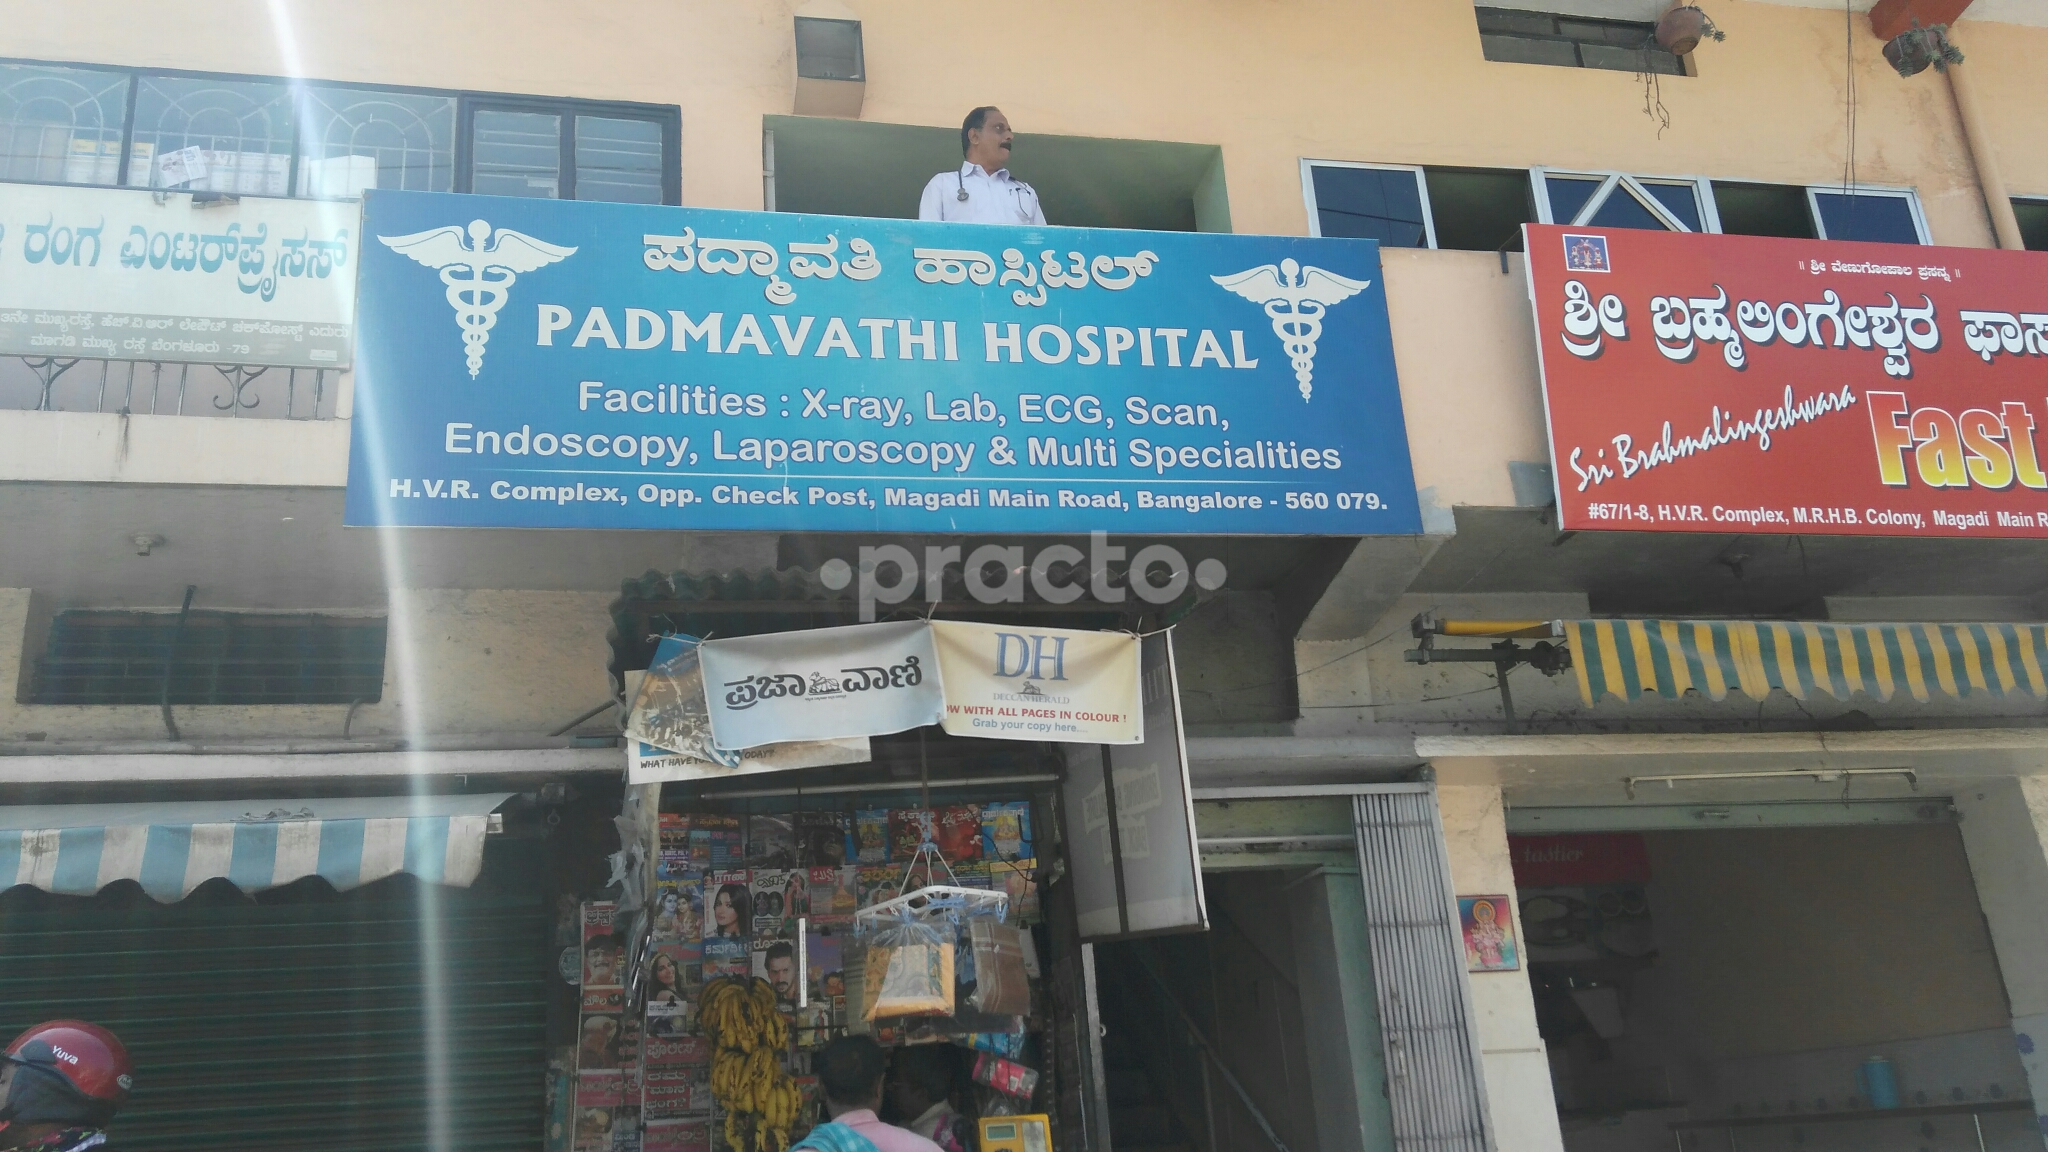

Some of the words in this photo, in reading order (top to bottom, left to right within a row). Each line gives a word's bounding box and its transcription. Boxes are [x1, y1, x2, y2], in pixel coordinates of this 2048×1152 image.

[24, 212, 104, 267] ರಂಗ
[642, 227, 882, 306] ಪದ್ಮಾವತಿ
[912, 248, 1159, 307] ಹಾಸ್ಪಿಟಲ್
[1810, 259, 1826, 275] ಶ್ರೀ
[1831, 260, 1912, 276] ವೇಣುಗೋಪಾಲ
[1917, 265, 1951, 282] ಪ್ರಸನ್ನ
[536, 303, 959, 362] PADMAVATHI
[983, 321, 1259, 370] HOSPITAL
[1561, 279, 1627, 358] ಶ್ರೀ
[1650, 283, 1940, 377] ಬ್ರಹ್ಮಲಿಂಗೇಶ್ವರ
[579, 380, 767, 418] Facilities
[801, 387, 914, 428] X-ray,
[925, 391, 1008, 429] Lab,
[1018, 393, 1114, 430] ECG,
[1125, 396, 1230, 432] Scan,
[444, 421, 699, 468] Endoscopy,
[713, 429, 975, 473] Laparoscopy
[987, 433, 1017, 466] &
[1026, 436, 1118, 468] Multi
[1129, 437, 1342, 475] Specialities
[1569, 446, 1614, 492] Sri
[1611, 384, 1857, 479] Brahmalingeshwara
[1866, 390, 2048, 489] Fast
[389, 478, 479, 500] H.V.R.
[490, 479, 628, 507] Complex,
[637, 483, 703, 508] Opp.
[711, 485, 800, 506] Check
[808, 487, 876, 509] Post,
[884, 487, 981, 513] Magadi
[988, 488, 1049, 508] Main
[1058, 489, 1129, 513] Road,
[1137, 490, 1263, 514] Bangalore
[1285, 493, 1330, 510] 560
[1336, 493, 1388, 510] 079.
[1588, 502, 1654, 524] #67/1-8,
[1658, 504, 1709, 522] H.V.R.
[1712, 505, 1790, 526] Complex,
[1793, 507, 1862, 524] M.R.H.B.
[1866, 508, 1926, 530] Colony,
[1933, 510, 1990, 530] Magadi
[1996, 511, 2035, 527] Main
[993, 632, 1070, 681] DH
[963, 705, 994, 715] WITH
[997, 706, 1018, 717] ALL
[1021, 708, 1056, 719] PAGES
[1059, 710, 1072, 719] IN
[1075, 711, 1119, 723] COLOUR
[993, 692, 1030, 702] DECCAN
[972, 717, 998, 728] Grab
[1000, 720, 1024, 733] your
[1027, 721, 1051, 734] copy
[640, 759, 666, 769] WHAT
[668, 757, 692, 767] HAVE
